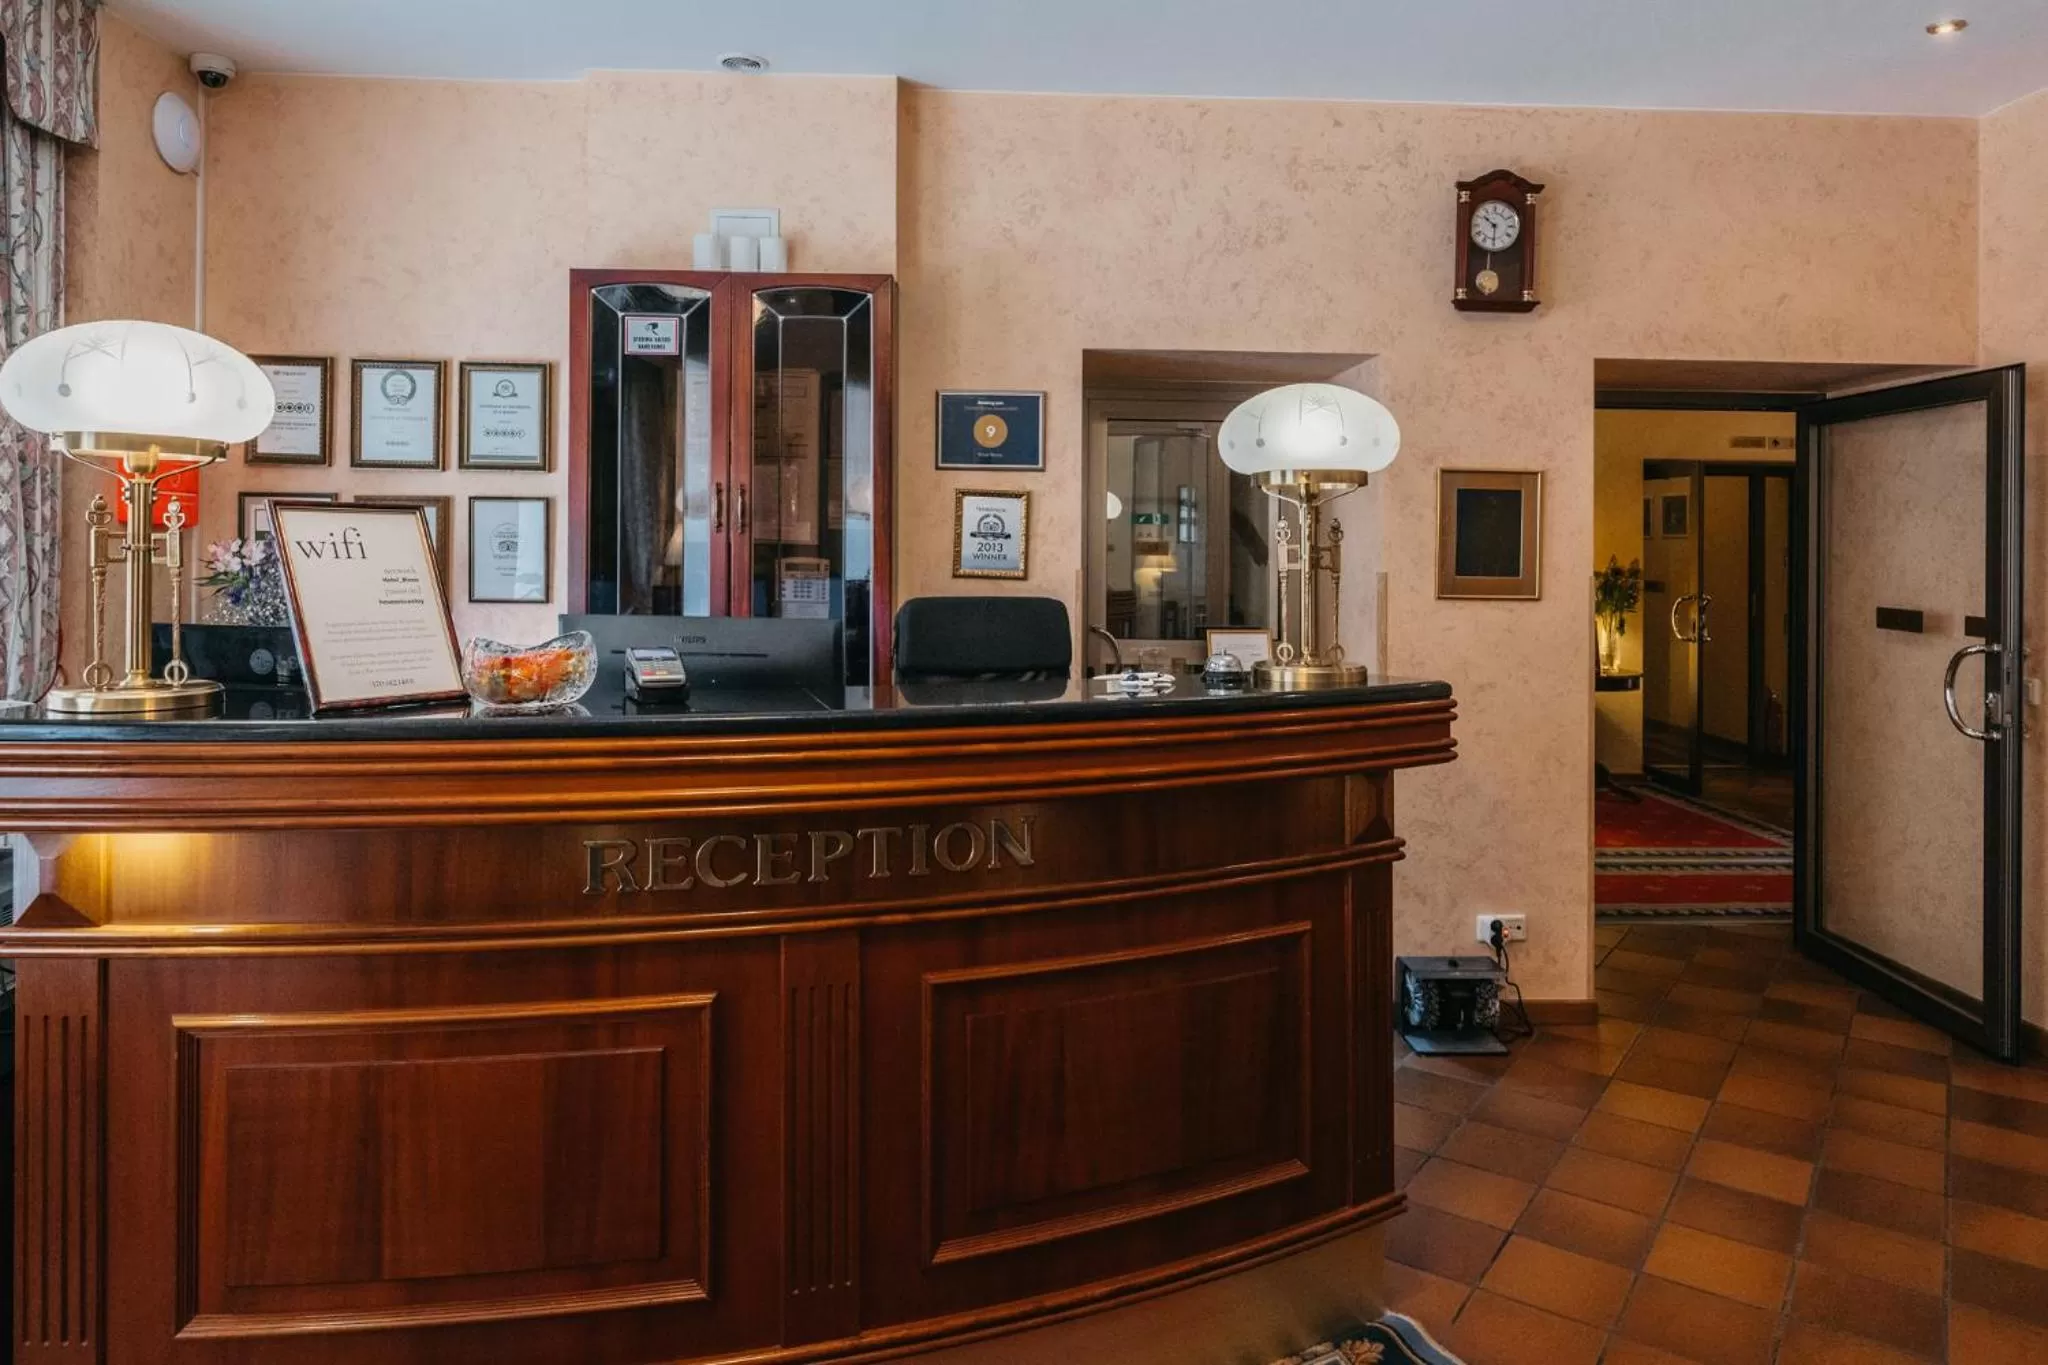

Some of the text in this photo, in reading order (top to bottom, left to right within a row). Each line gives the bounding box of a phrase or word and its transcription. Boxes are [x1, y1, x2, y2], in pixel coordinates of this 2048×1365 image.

[985, 425, 996, 438] 9
[295, 526, 368, 559] wifi
[977, 542, 1003, 552] 2013
[972, 552, 1007, 560] WINNER
[581, 814, 1038, 895] RECEPTION
